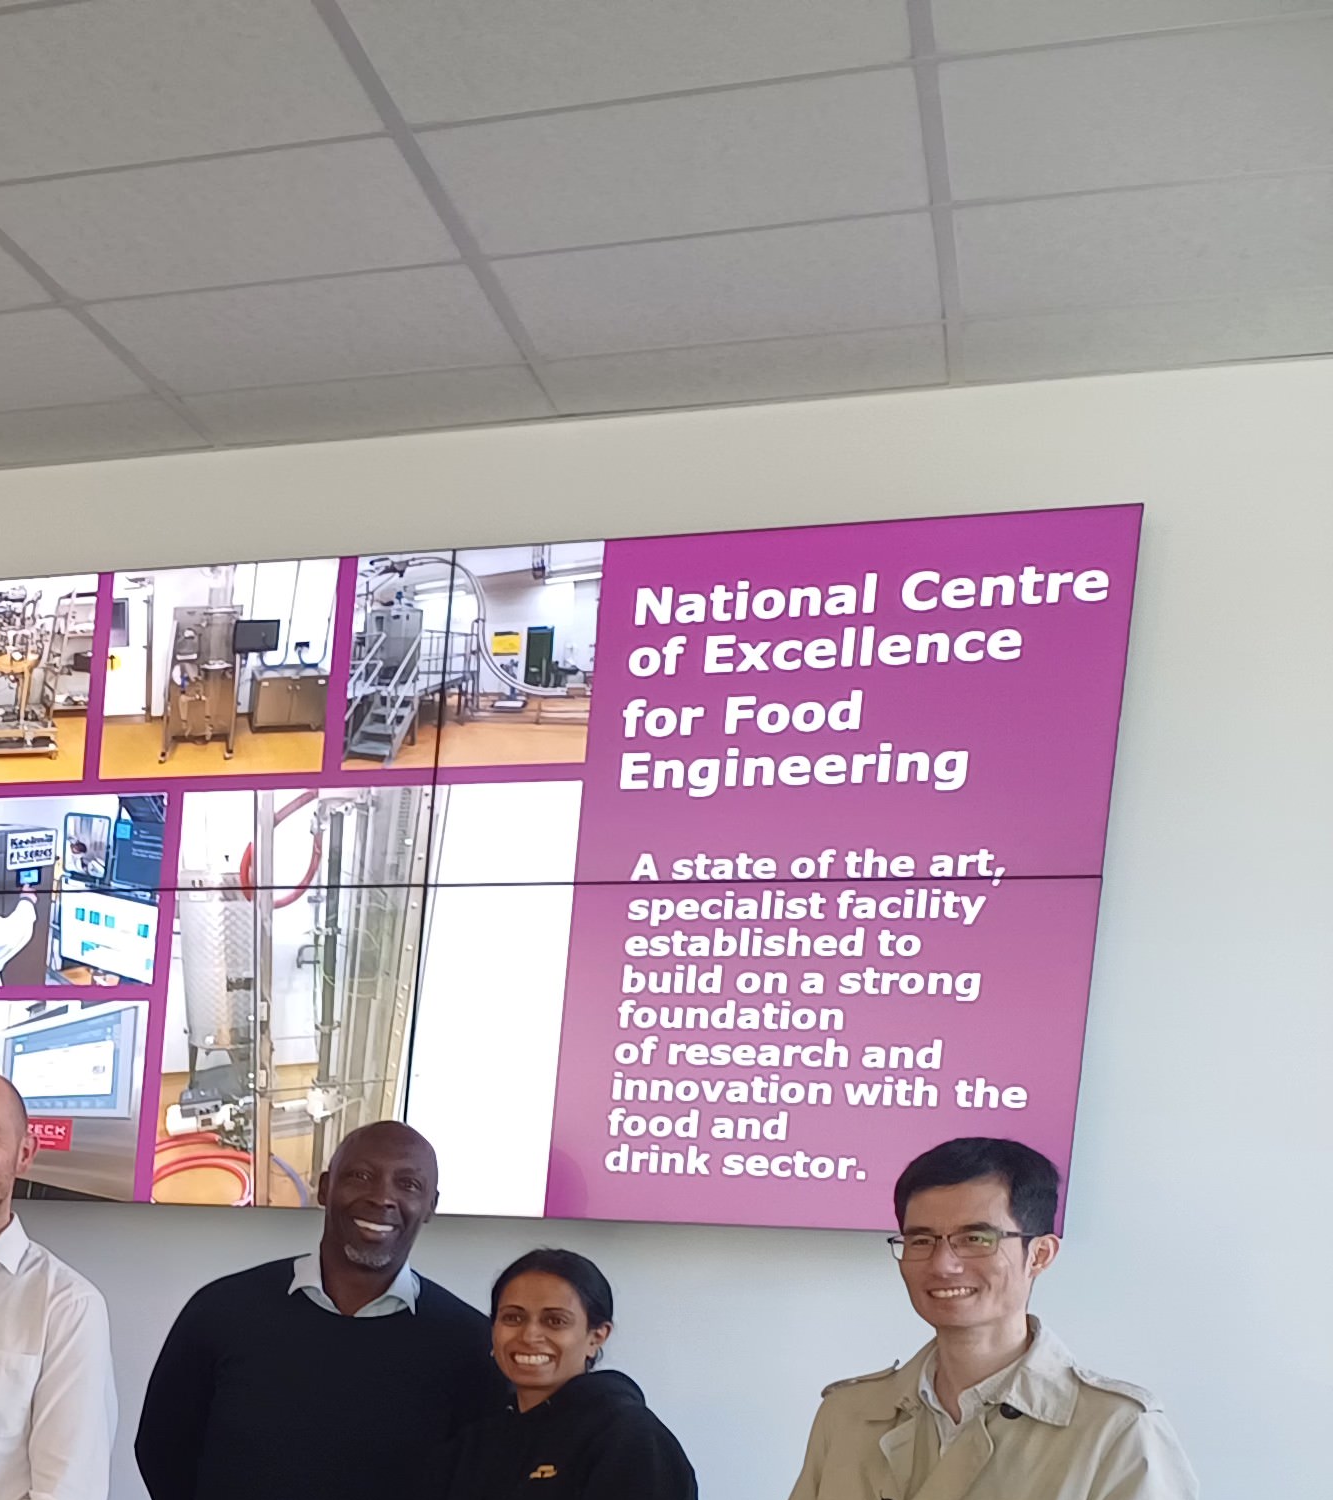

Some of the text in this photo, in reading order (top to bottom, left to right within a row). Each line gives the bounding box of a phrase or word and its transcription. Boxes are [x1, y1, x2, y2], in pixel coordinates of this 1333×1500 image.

[634, 566, 1109, 626] National Centre
[628, 625, 1022, 677] of Excellence
[622, 689, 863, 738] for Food
[619, 742, 969, 798] Engineering
[630, 848, 1006, 887] A state of the art,
[627, 888, 987, 927] specialist facility
[624, 926, 921, 957] established to
[622, 964, 982, 1002] build on a strong
[617, 999, 844, 1031] foundation
[614, 1035, 943, 1070] of research and
[611, 1071, 1028, 1109] innovation with the
[607, 1107, 788, 1141] food and
[604, 1143, 866, 1180] drink sector.
